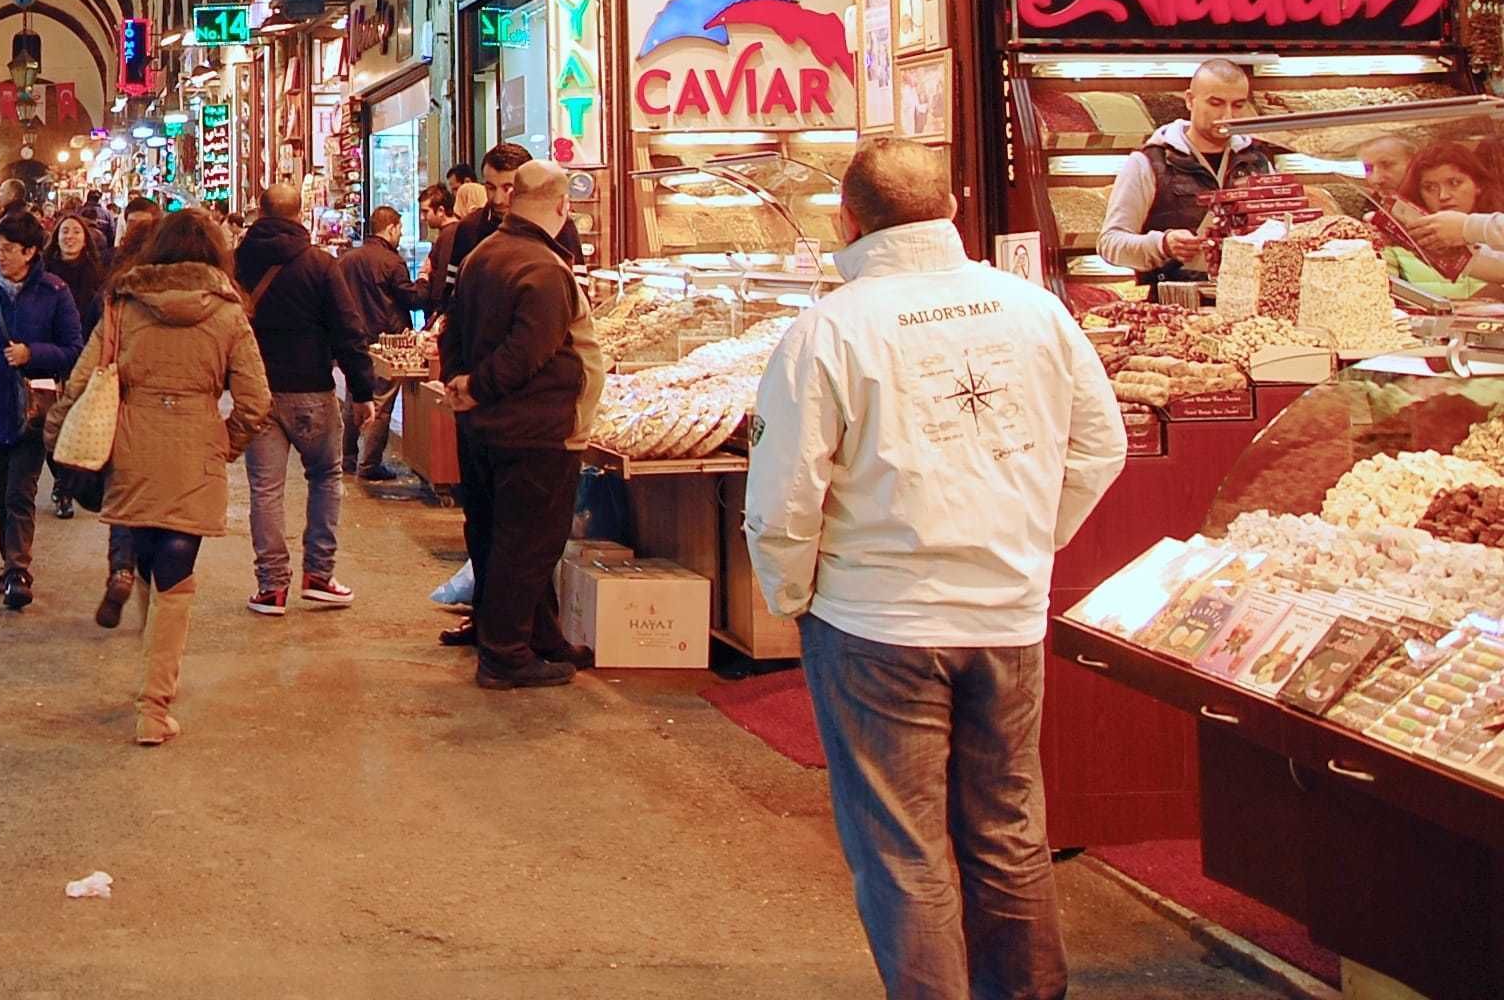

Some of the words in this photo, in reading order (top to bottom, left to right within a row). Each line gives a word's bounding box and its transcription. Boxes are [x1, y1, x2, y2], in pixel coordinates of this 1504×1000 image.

[634, 41, 834, 115] CAVIAR
[1002, 59, 1015, 181] SPICES
[898, 304, 966, 327] SAILOR'S
[629, 619, 674, 630] HAYAT
